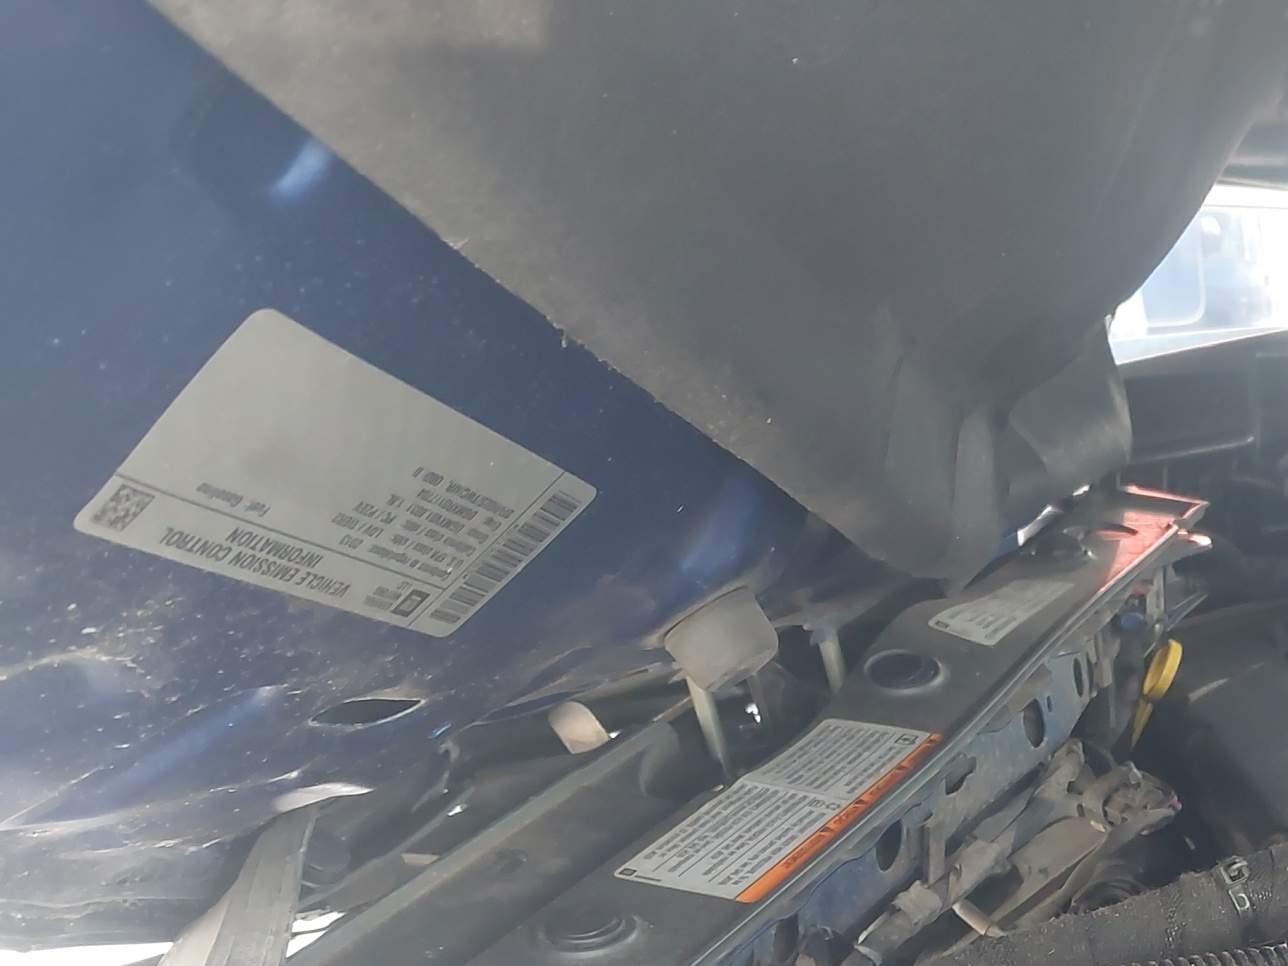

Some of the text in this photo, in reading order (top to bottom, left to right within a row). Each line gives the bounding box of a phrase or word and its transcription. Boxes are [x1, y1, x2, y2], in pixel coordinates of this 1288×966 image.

[160, 527, 351, 598] VEHICLE EMISSION CONTROL
[226, 528, 323, 568] INFORMATION
